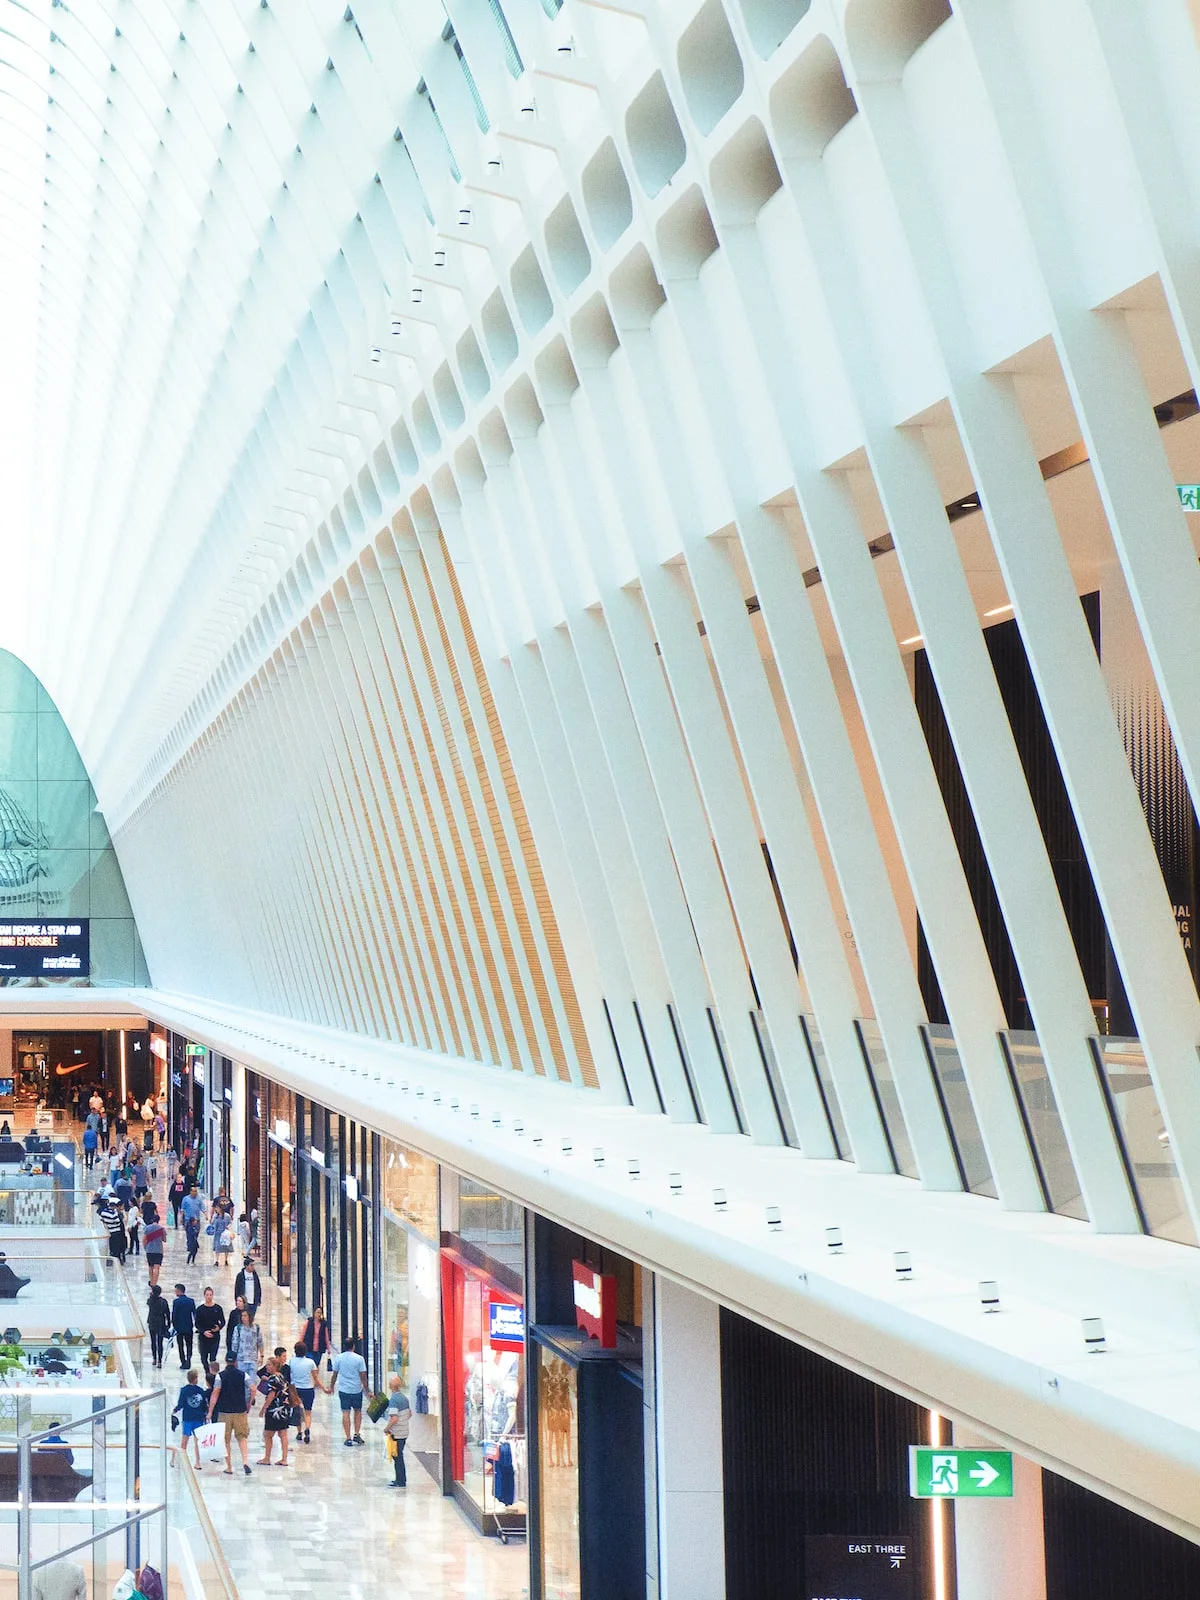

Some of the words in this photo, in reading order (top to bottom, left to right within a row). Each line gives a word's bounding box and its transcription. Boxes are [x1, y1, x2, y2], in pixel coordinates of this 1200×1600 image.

[12, 925, 40, 936] BECOME
[41, 925, 47, 936] A
[47, 925, 65, 936] STAR
[66, 925, 81, 936] AND
[16, 936, 25, 947] IS
[25, 936, 58, 947] POSSIBLE
[848, 1544, 873, 1554] EAST
[874, 1544, 906, 1554] THREE
